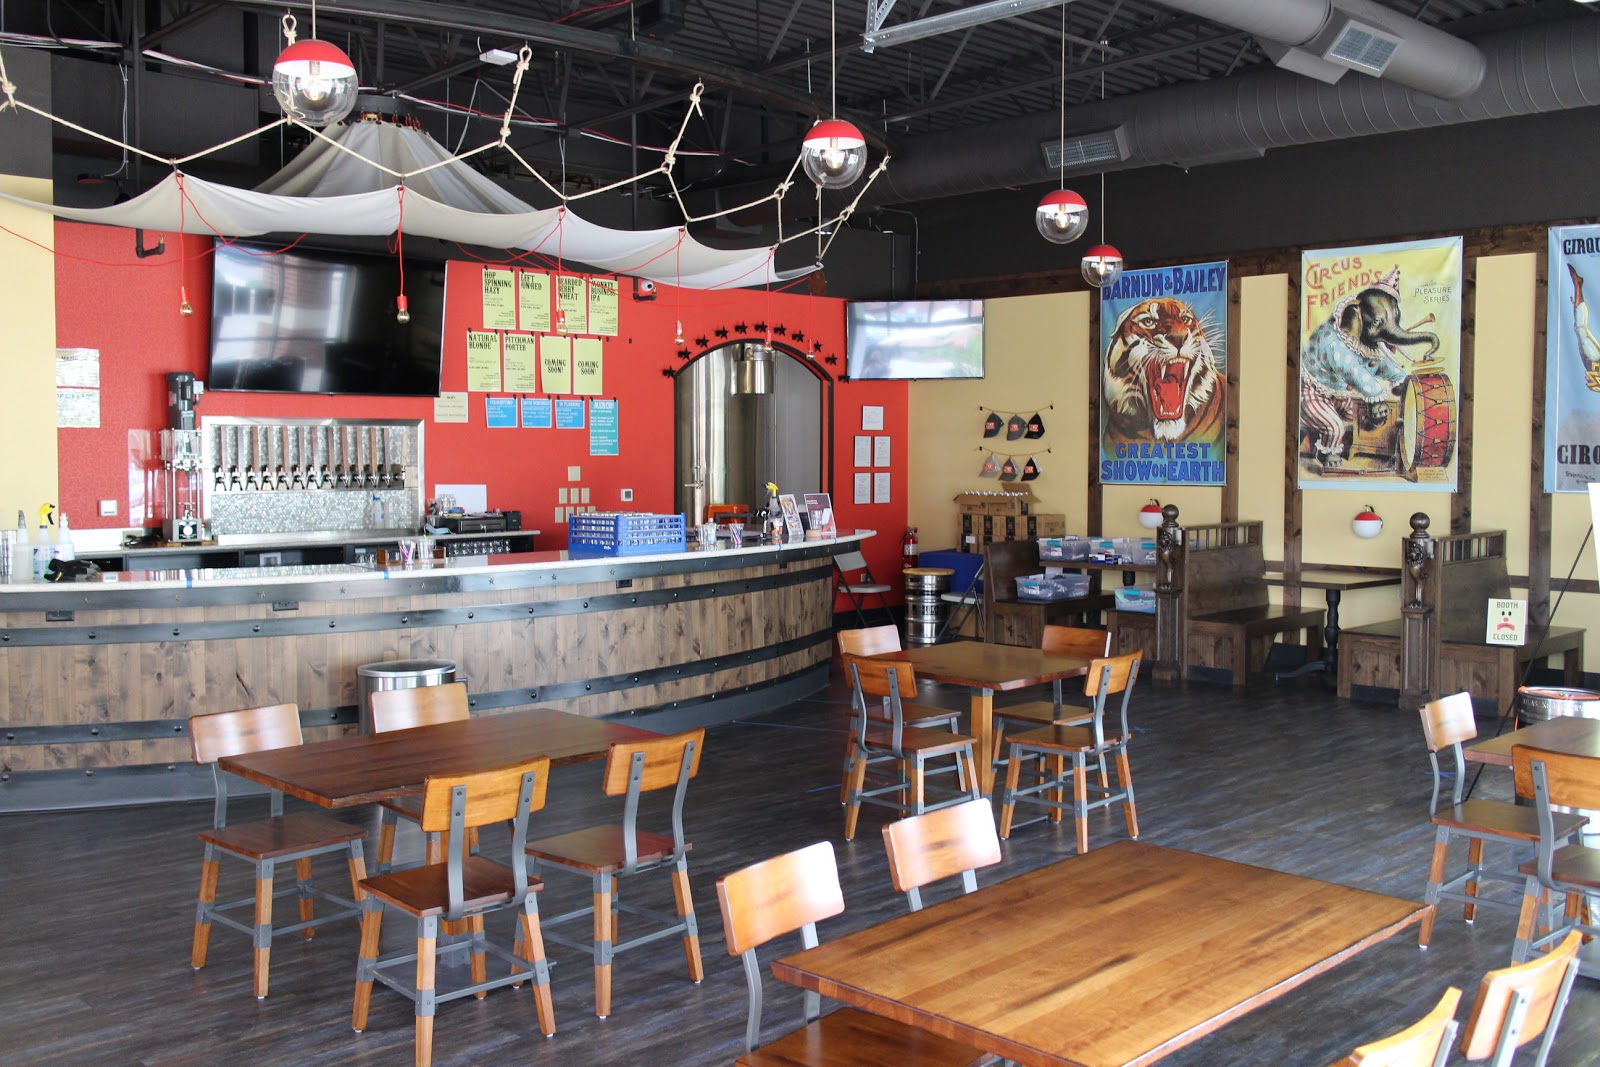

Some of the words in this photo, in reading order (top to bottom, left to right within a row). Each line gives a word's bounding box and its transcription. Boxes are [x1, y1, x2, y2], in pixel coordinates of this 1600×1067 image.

[484, 271, 496, 279] HOP
[1306, 257, 1362, 289] CIRCUS
[521, 274, 535, 282] LEFT
[1164, 276, 1173, 291] &
[1173, 268, 1227, 295] BAILEY
[484, 279, 512, 288] SPINNING
[484, 286, 500, 294] HAZY
[1413, 286, 1452, 298] PLEASURE
[591, 294, 601, 302] IPA
[1307, 269, 1382, 332] FRIEND'S
[1424, 295, 1450, 304] SERIES
[469, 333, 498, 342] NATURAL
[505, 336, 534, 344] PITCHMAN
[469, 342, 492, 350] BLONDE
[545, 359, 566, 367] COMING
[578, 360, 599, 368] COMING
[548, 366, 564, 374] SOON!
[1115, 443, 1211, 459] GREATEST
[1101, 460, 1152, 481] SHOW
[1152, 464, 1166, 478] ON
[1168, 461, 1224, 482] EARTH
[1496, 601, 1518, 609] BOOTH
